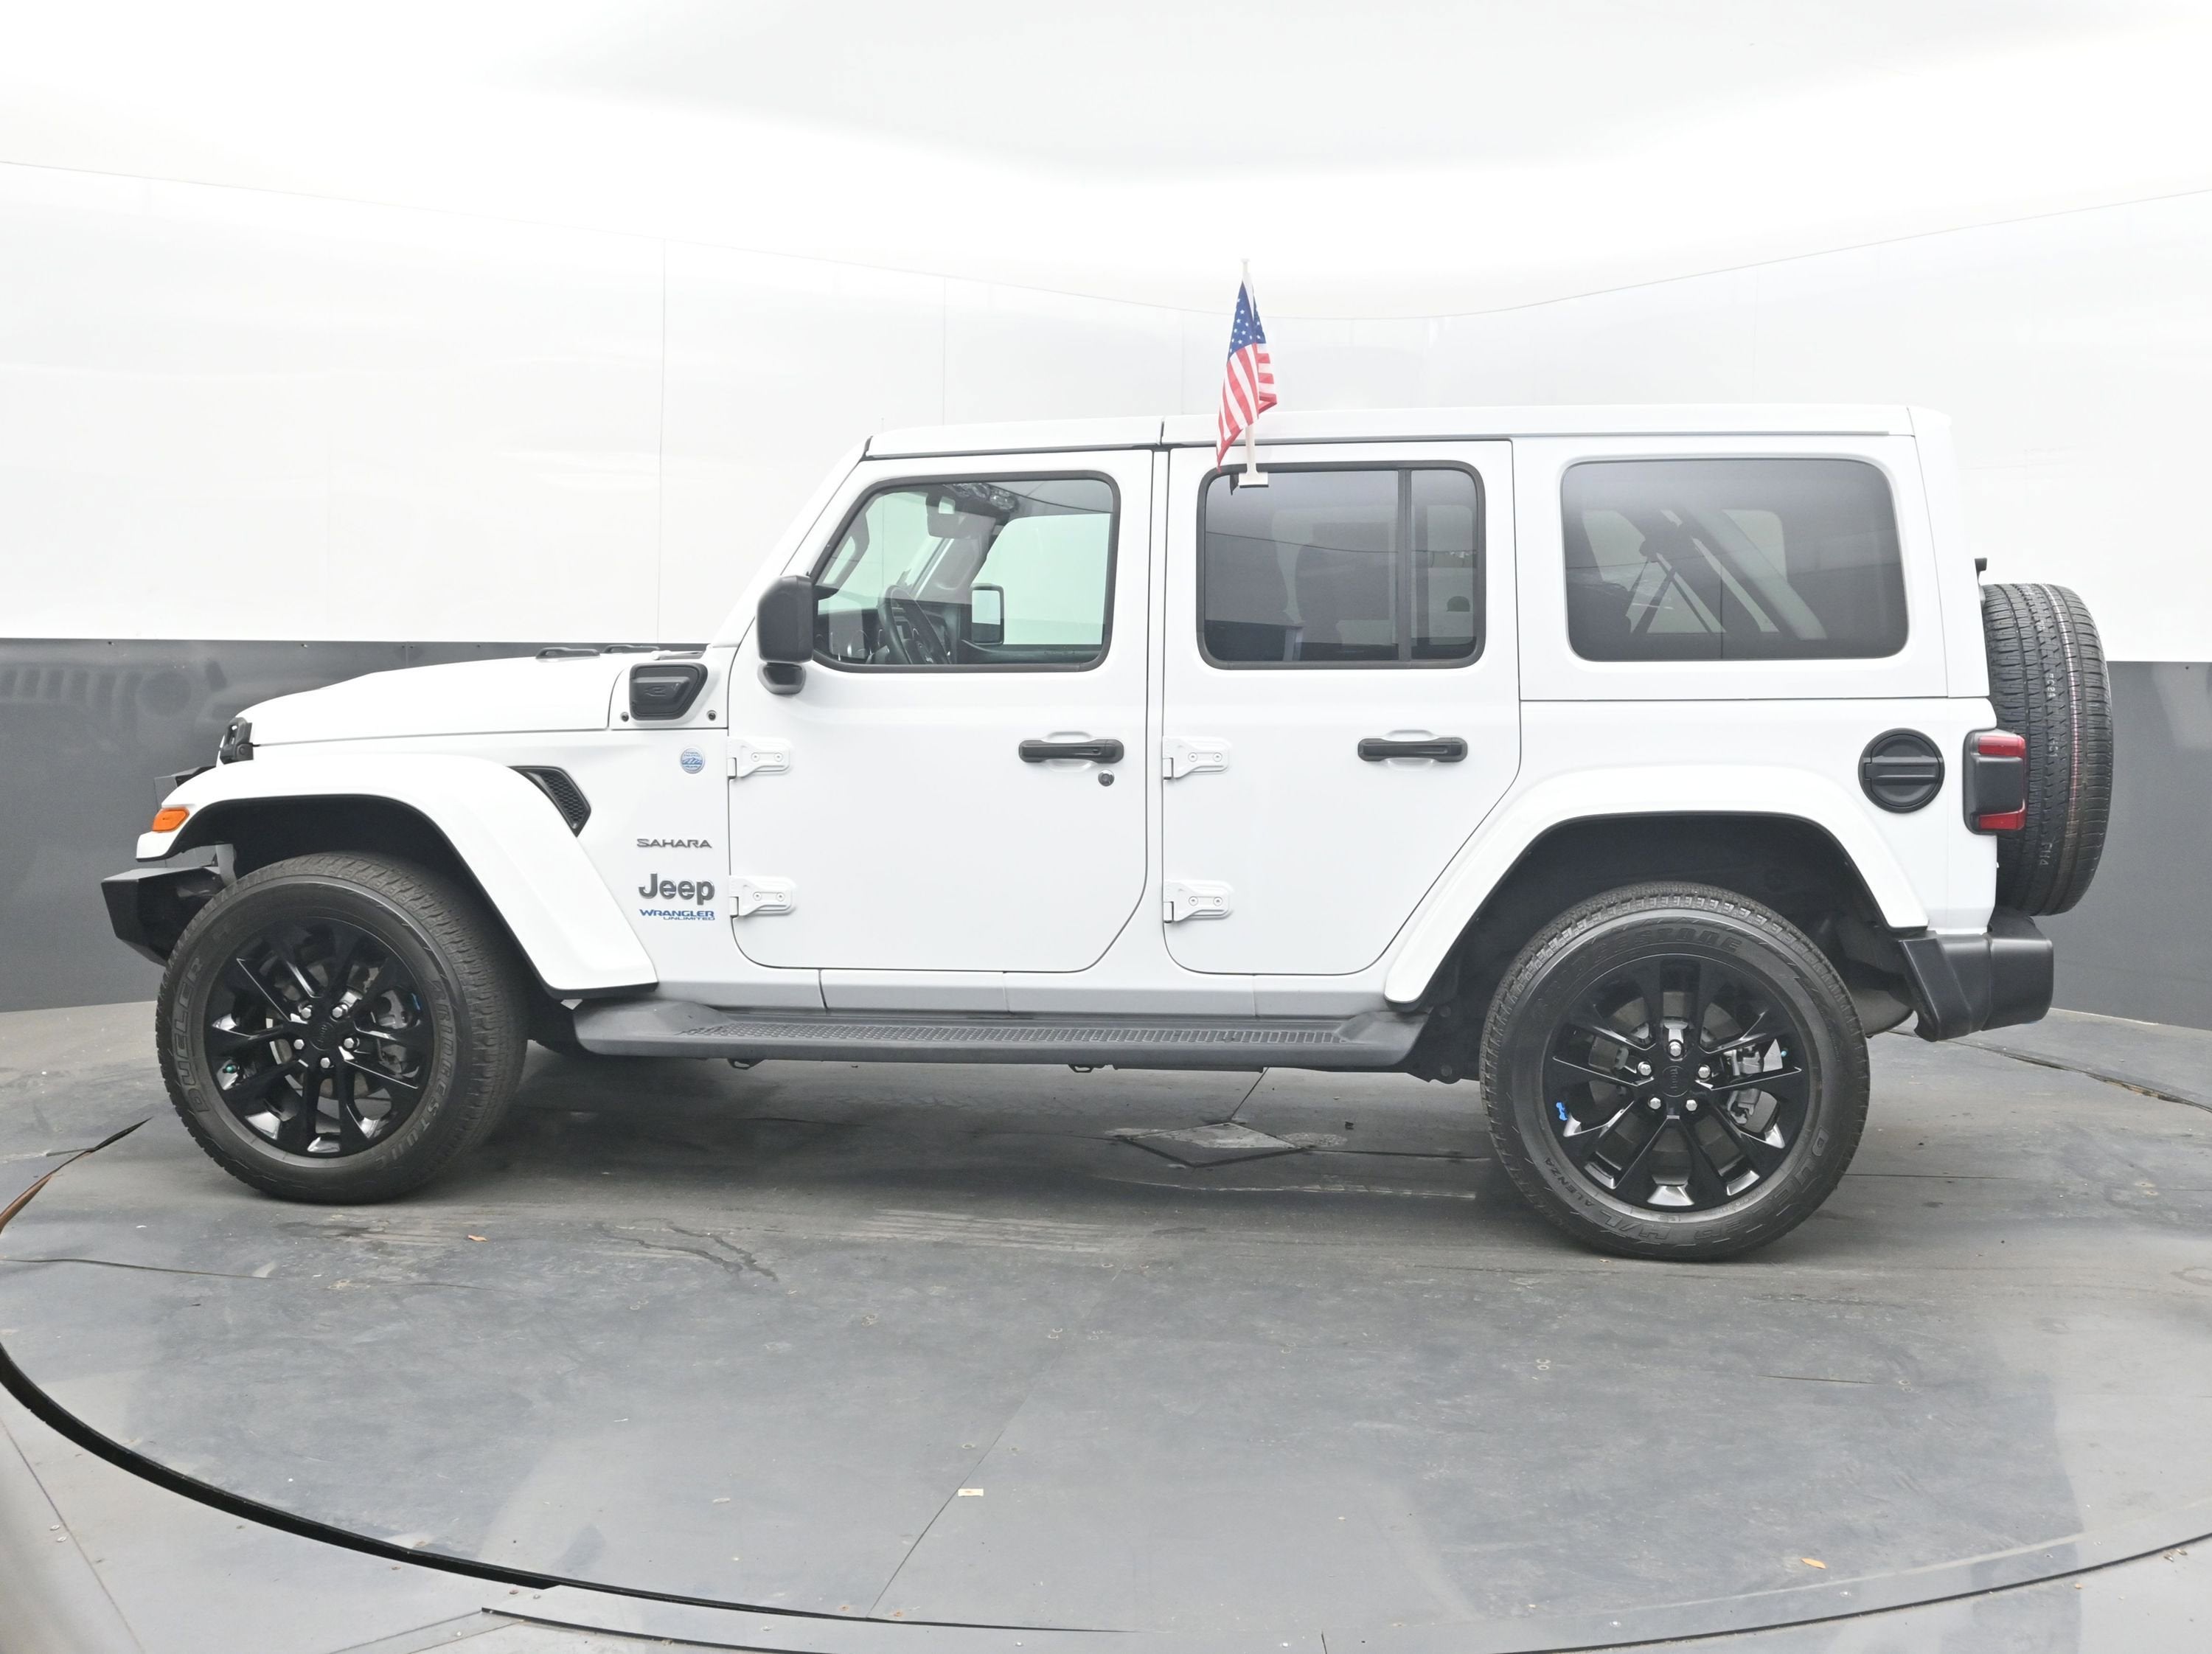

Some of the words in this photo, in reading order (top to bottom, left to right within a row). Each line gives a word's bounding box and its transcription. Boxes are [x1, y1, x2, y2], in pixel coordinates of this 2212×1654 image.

[636, 838, 712, 848] SAHARA
[638, 873, 715, 906] Jeep
[639, 909, 714, 917] WRANGLER
[174, 957, 210, 1113] DUELER
[1545, 1158, 1595, 1207] ALENZA
